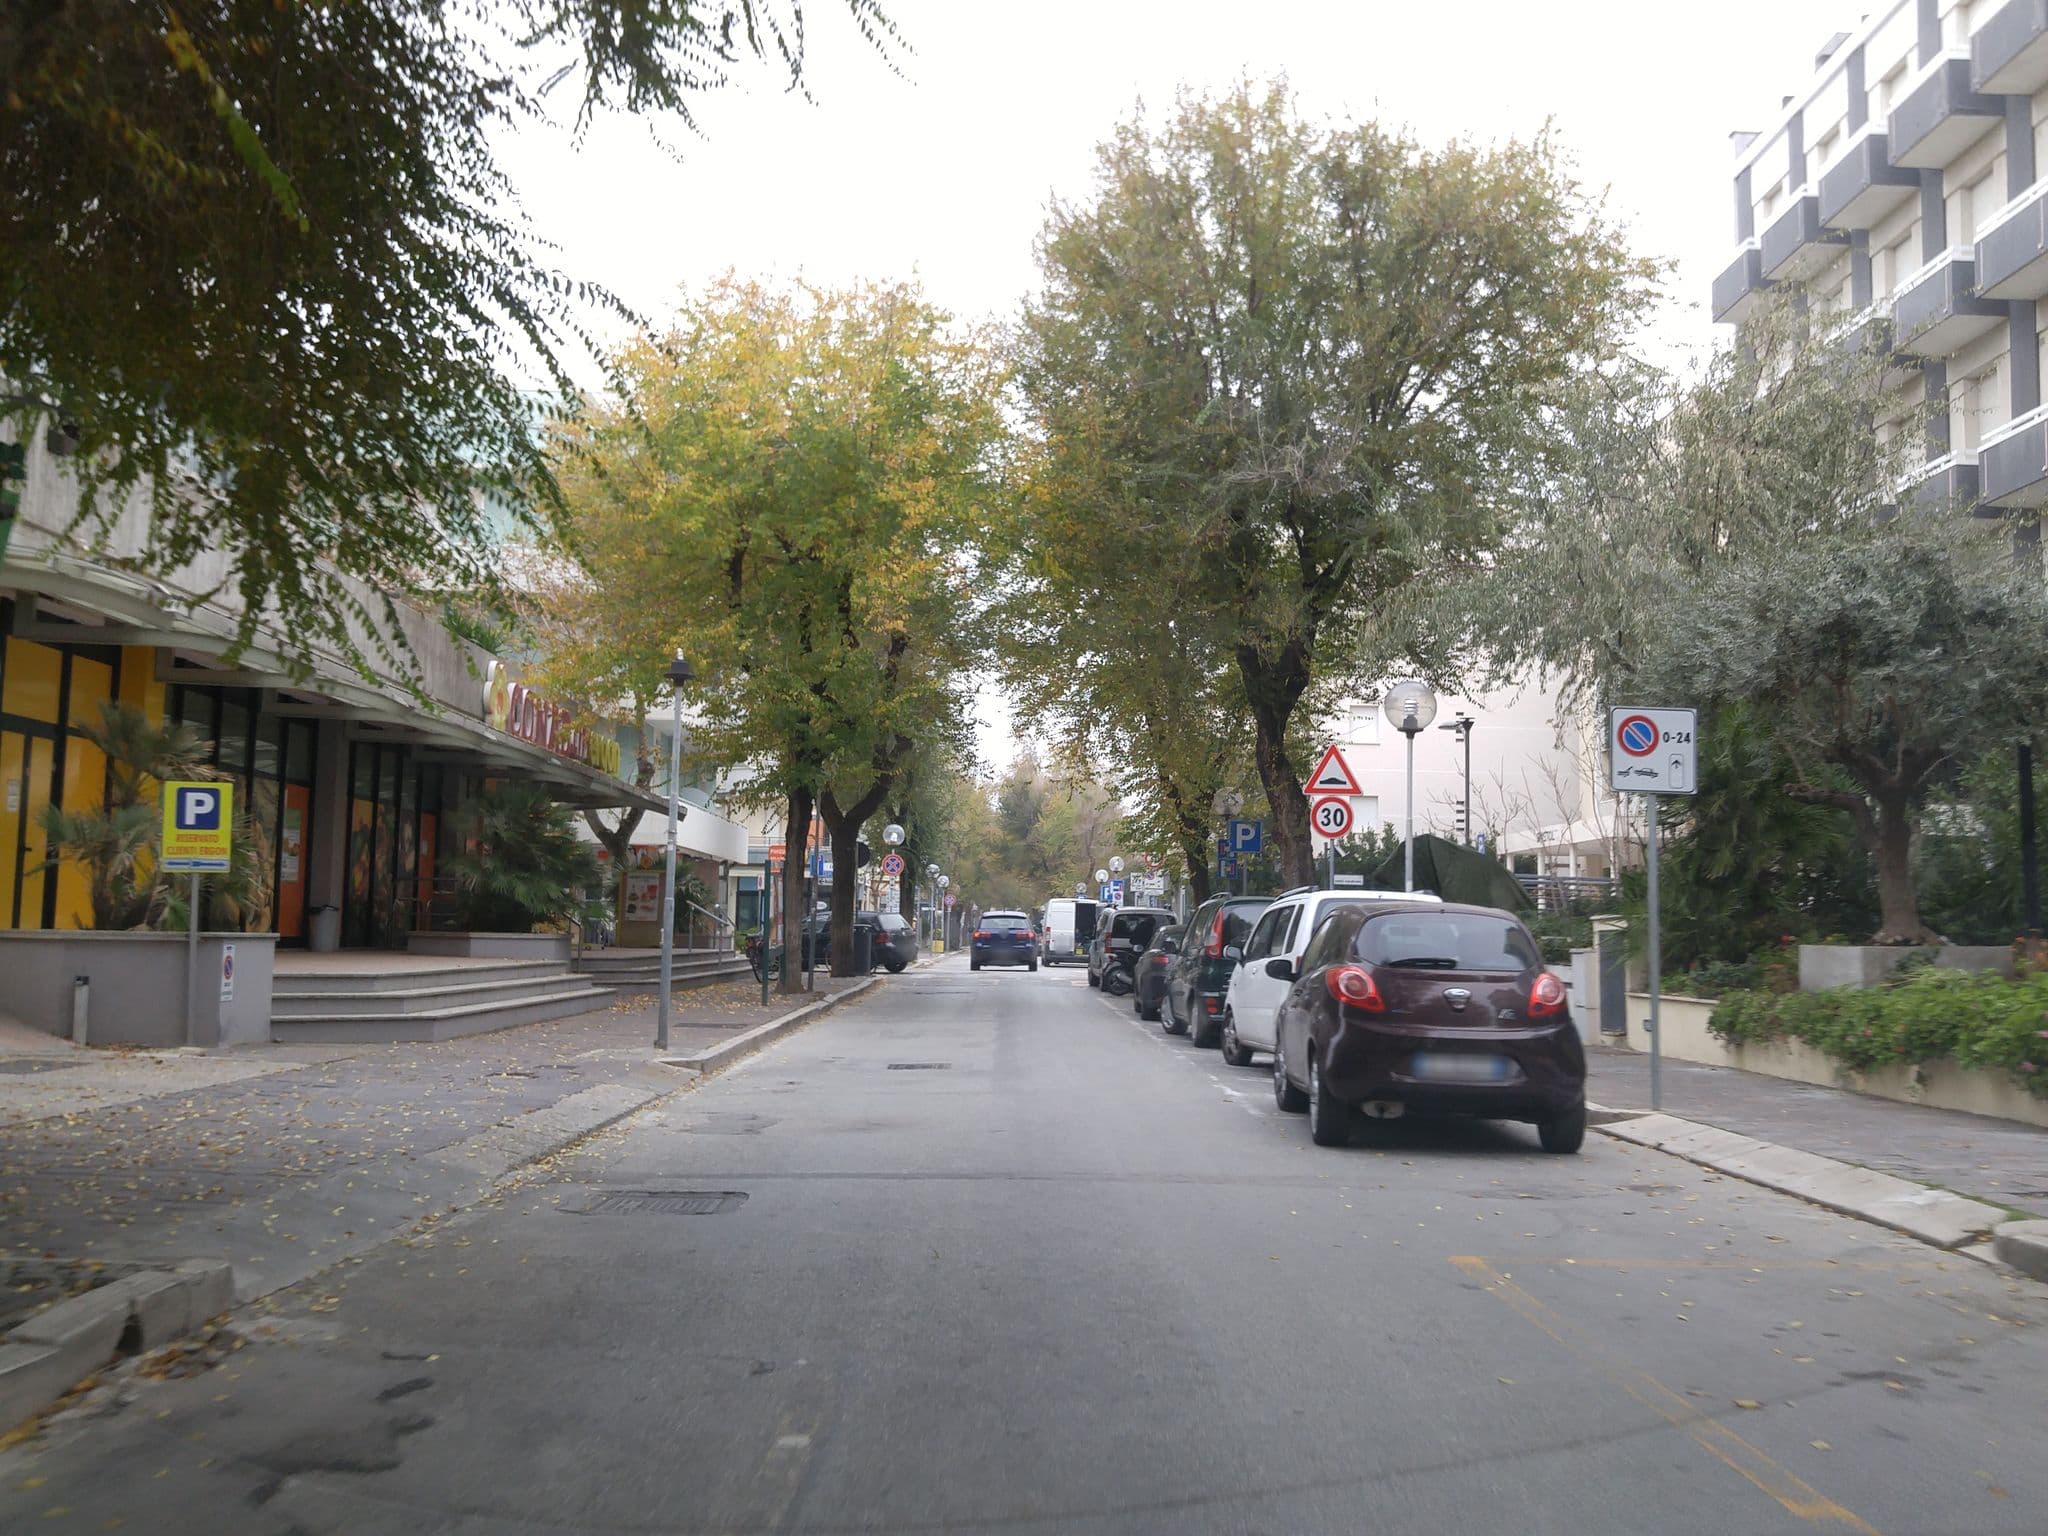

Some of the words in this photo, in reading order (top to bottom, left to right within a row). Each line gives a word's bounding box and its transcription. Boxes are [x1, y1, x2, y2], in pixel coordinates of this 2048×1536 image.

[1662, 731, 1691, 744] 0-24
[184, 792, 214, 825] P
[1321, 807, 1344, 827] 30
[1236, 823, 1256, 849] P
